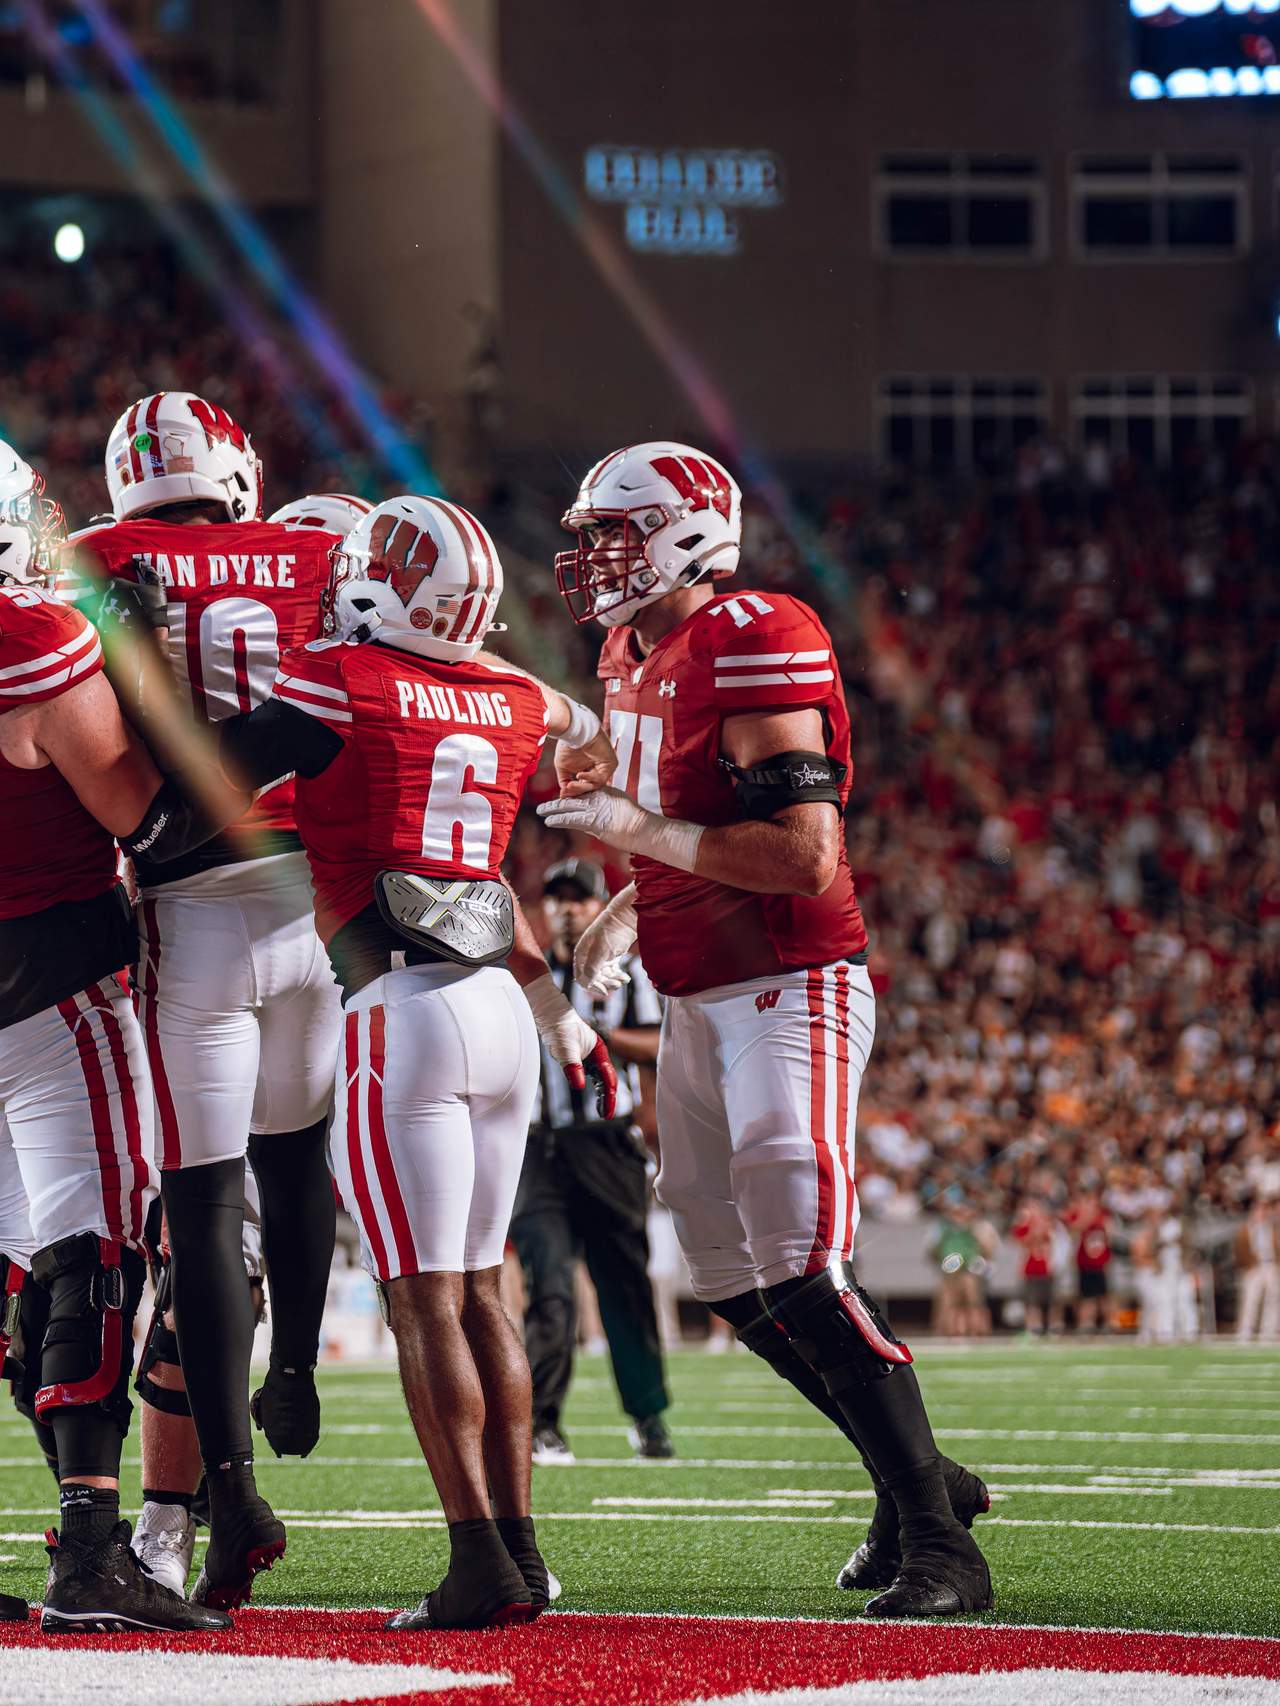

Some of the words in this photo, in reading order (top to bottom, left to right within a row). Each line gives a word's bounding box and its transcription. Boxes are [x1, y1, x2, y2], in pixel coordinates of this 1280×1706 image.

[207, 554, 296, 588] DYKE
[395, 680, 513, 727] PAULING
[421, 733, 499, 871] 6
